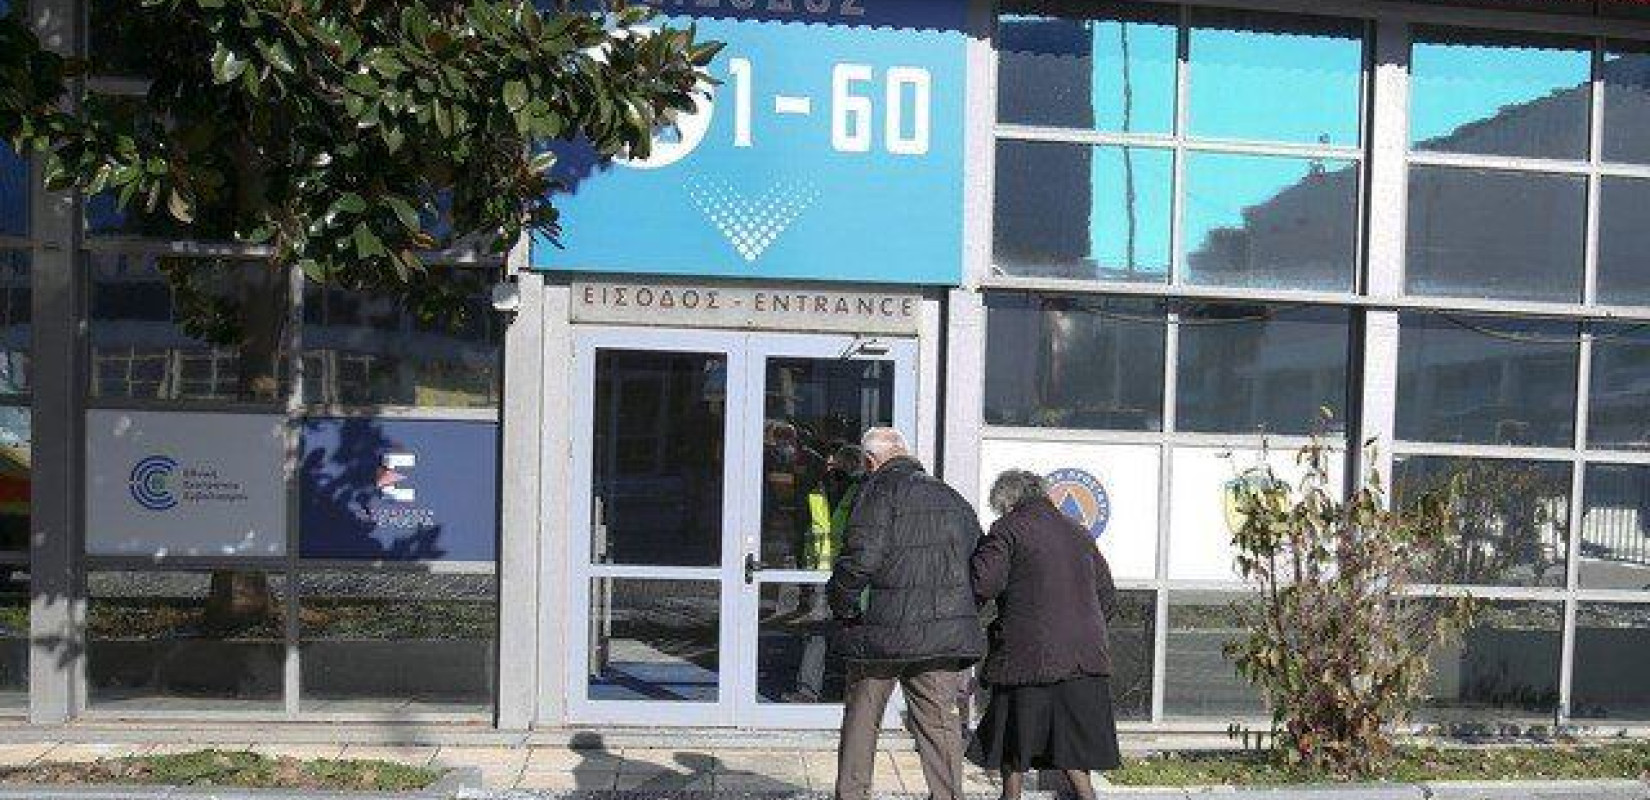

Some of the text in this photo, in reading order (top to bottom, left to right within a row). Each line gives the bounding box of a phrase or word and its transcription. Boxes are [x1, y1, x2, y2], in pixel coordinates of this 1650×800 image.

[832, 63, 931, 155] 60
[584, 286, 720, 310] ΕΙΣΟΔΟΣ
[755, 292, 913, 318] ENTRANCE
